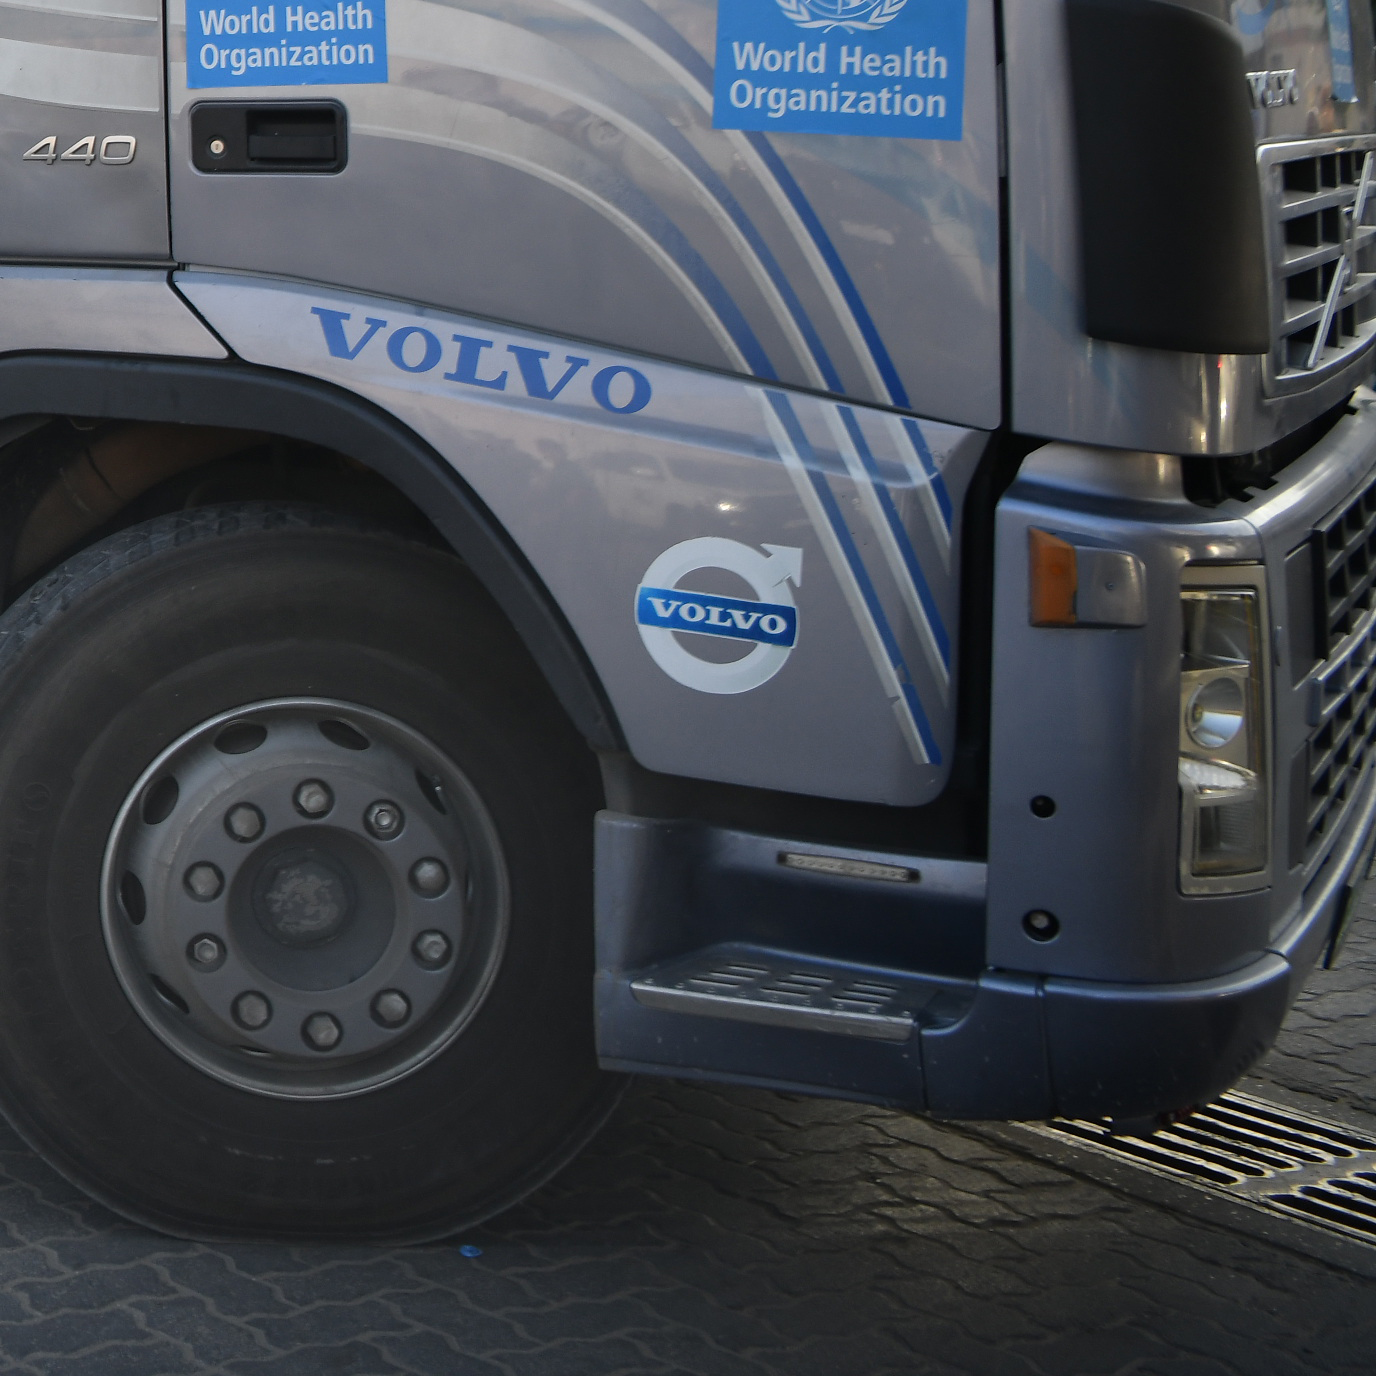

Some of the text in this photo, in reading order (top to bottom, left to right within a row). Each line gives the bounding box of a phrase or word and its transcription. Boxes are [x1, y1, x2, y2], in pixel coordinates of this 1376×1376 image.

[199, 1, 374, 36] World Health
[199, 38, 375, 71] Organization
[732, 40, 948, 80] World Health
[729, 80, 947, 119] Organization
[23, 133, 137, 166] 440
[310, 307, 653, 416] VOLVO
[647, 598, 788, 637] VOLVO
